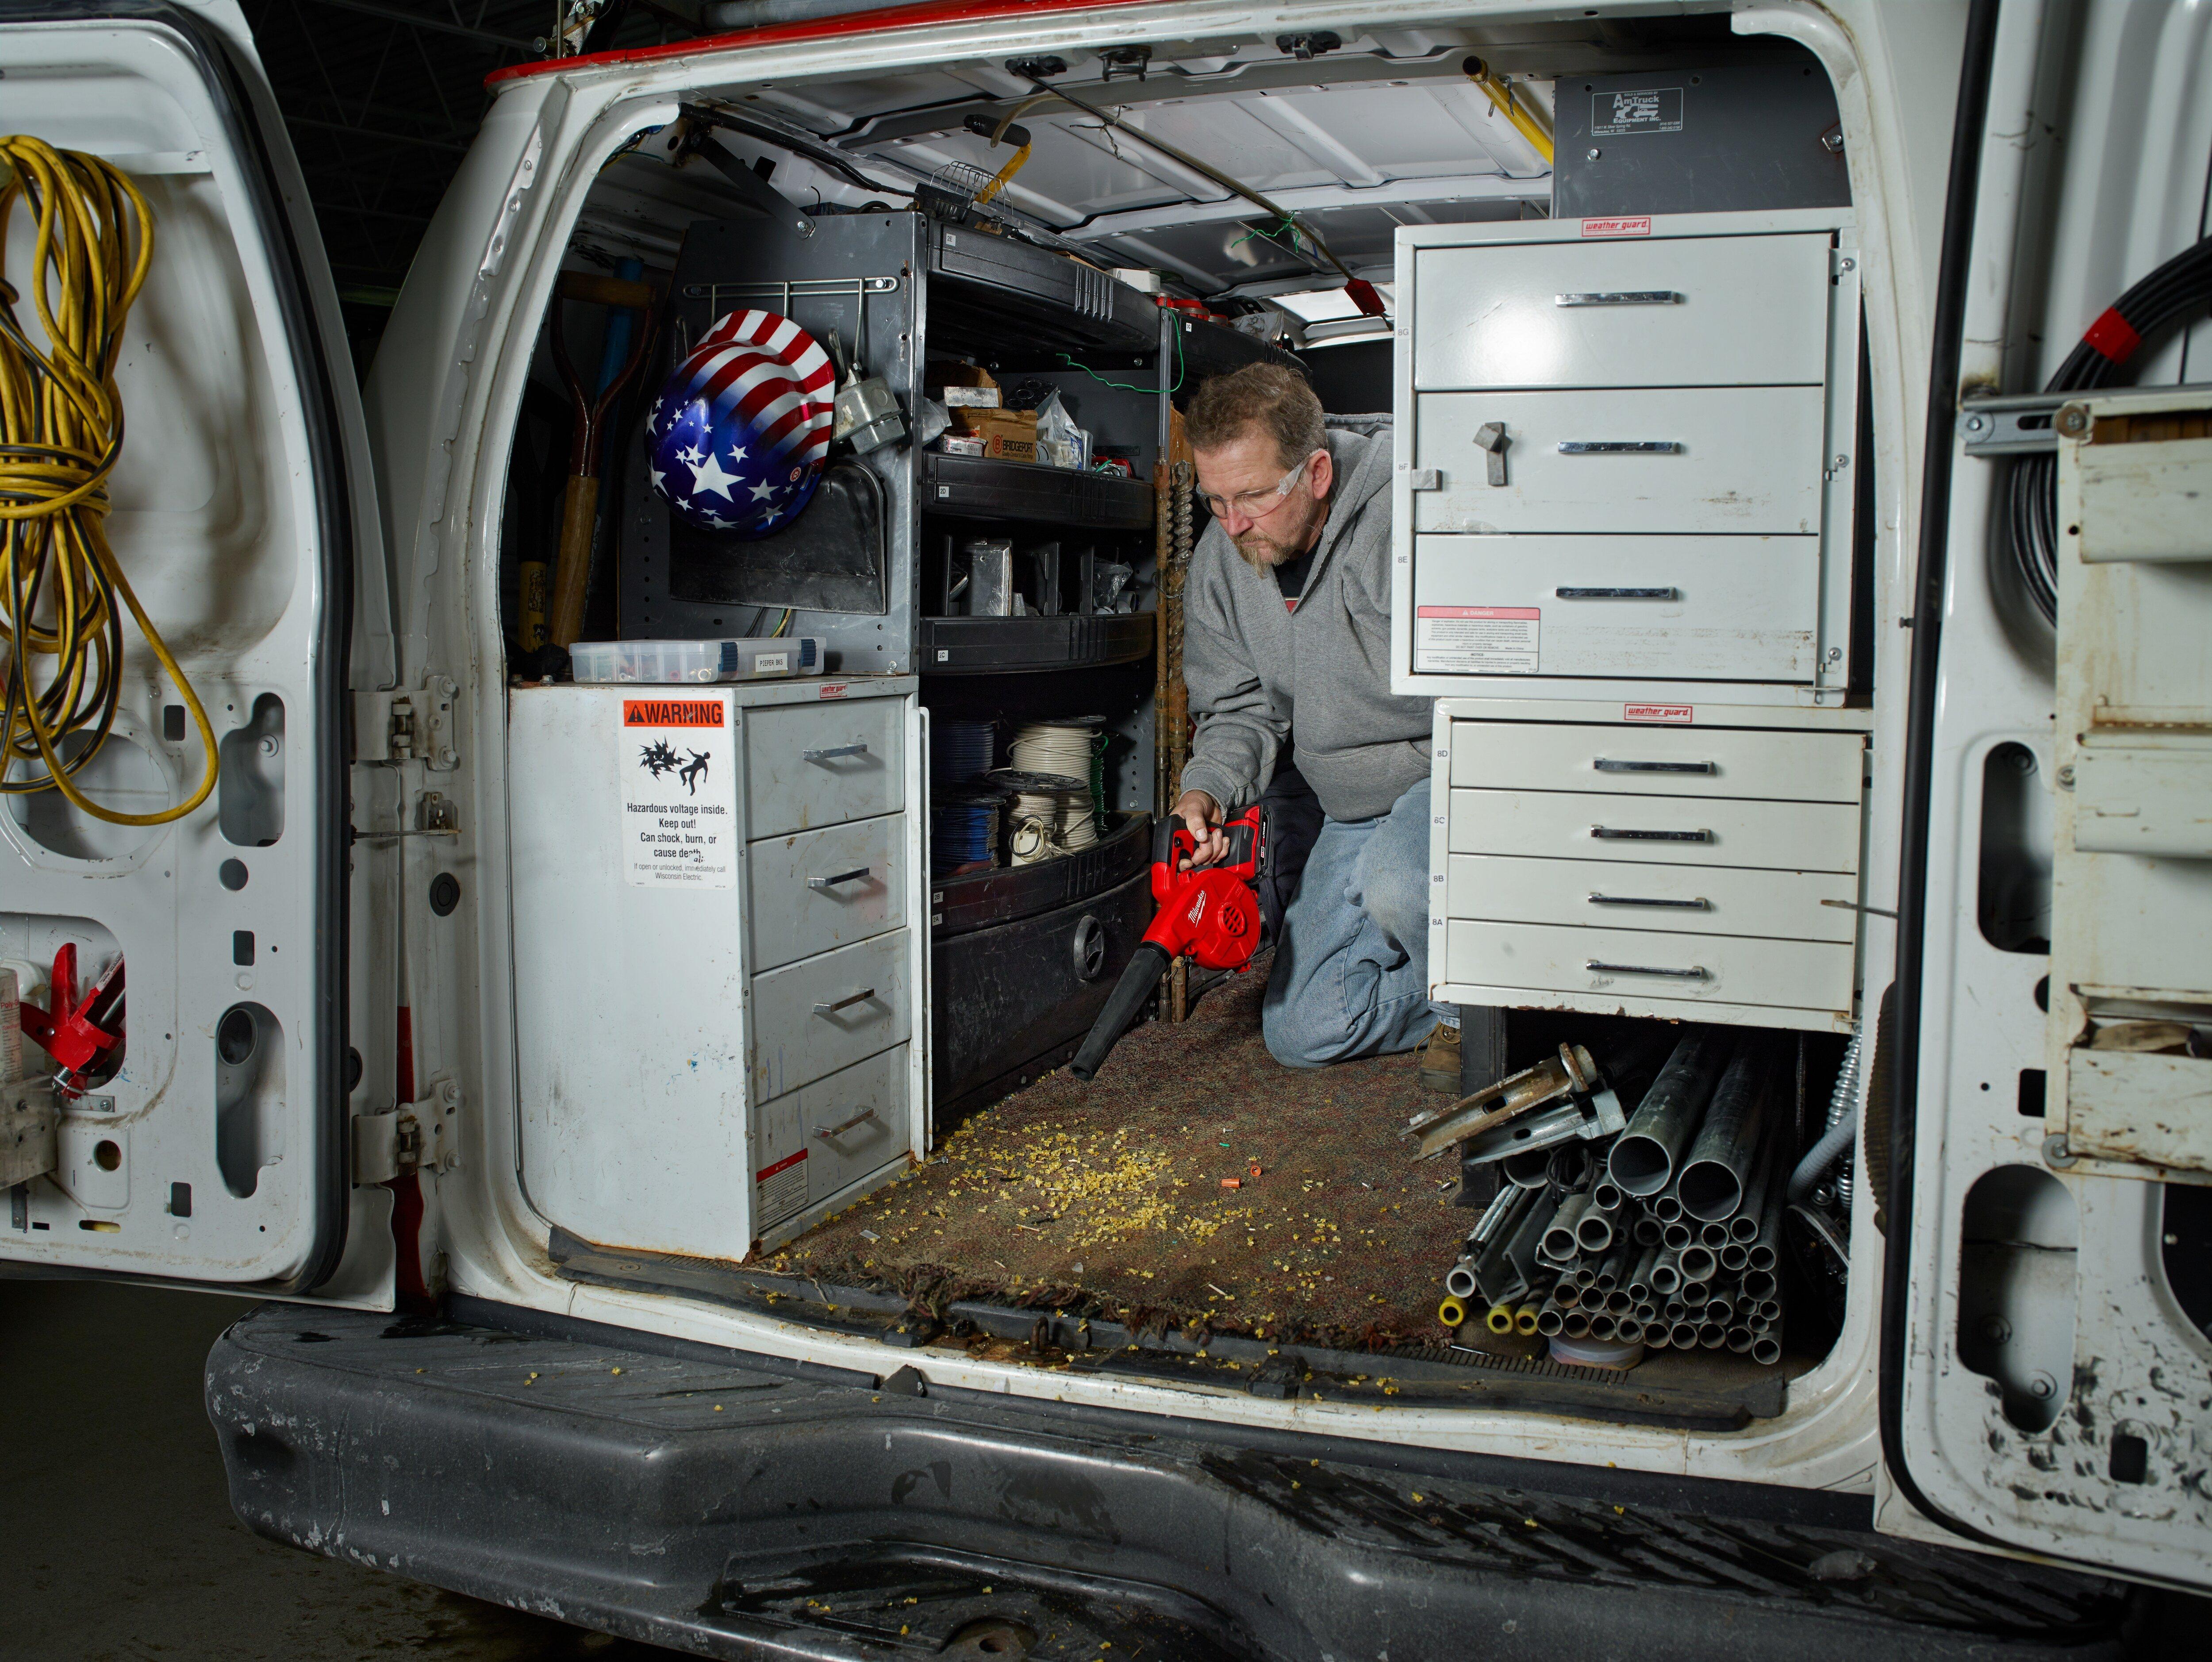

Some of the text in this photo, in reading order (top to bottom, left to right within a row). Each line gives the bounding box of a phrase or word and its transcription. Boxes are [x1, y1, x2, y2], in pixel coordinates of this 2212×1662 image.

[1613, 94, 1659, 108] AmTruck
[1622, 220, 1647, 230] guard
[1002, 439, 1033, 453] BRIDGEPORT
[645, 704, 722, 724] WARNING
[1664, 708, 1688, 717] guard
[627, 803, 728, 815] Hazardous voltage inside.
[659, 818, 696, 830] Keep out!
[641, 832, 655, 842] Can
[657, 833, 683, 844] shock,
[685, 834, 706, 844] burn,
[1188, 890, 1205, 923] Milwaukee
